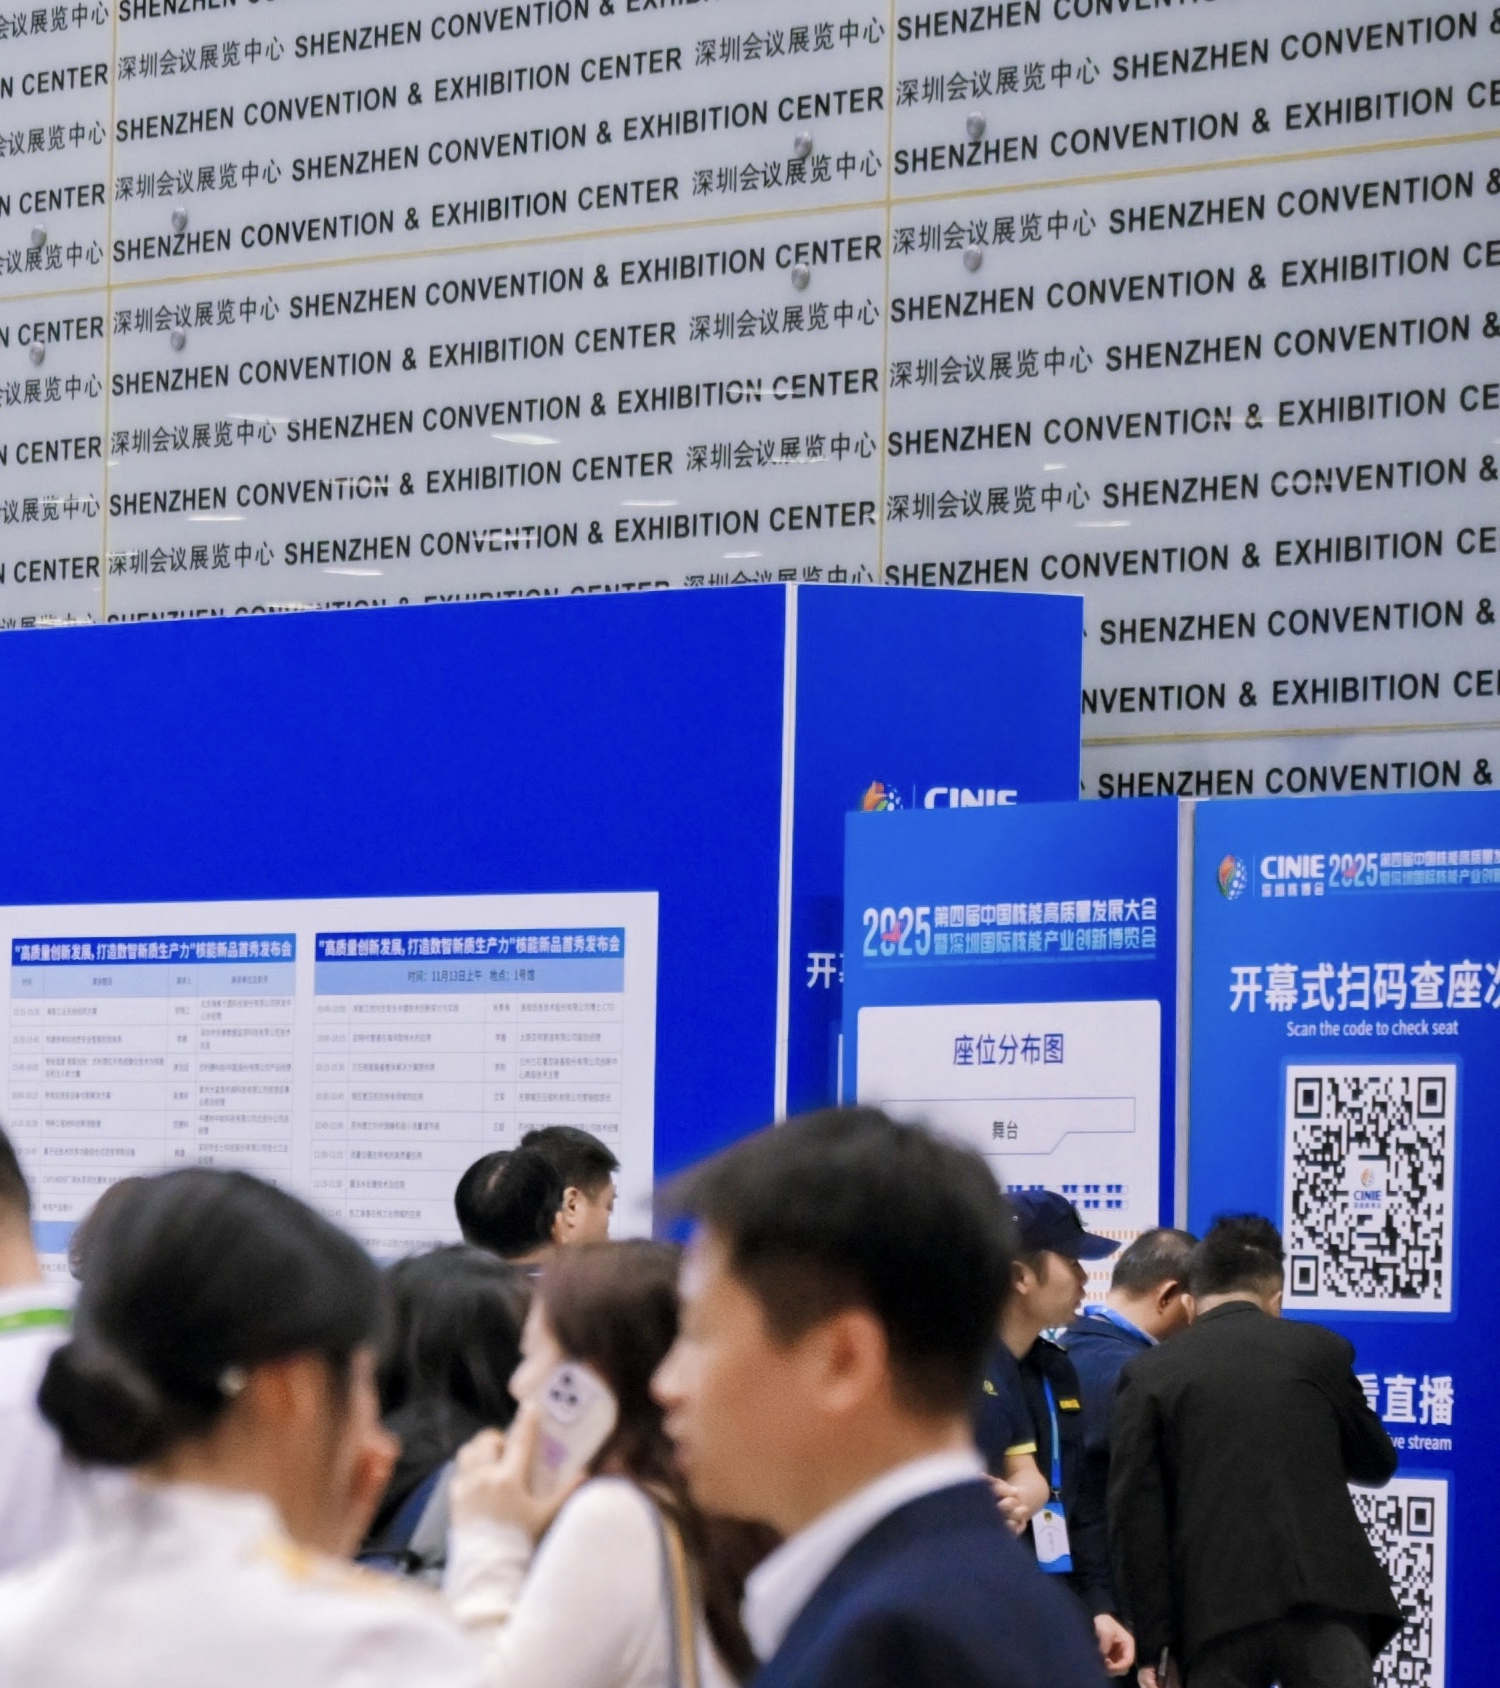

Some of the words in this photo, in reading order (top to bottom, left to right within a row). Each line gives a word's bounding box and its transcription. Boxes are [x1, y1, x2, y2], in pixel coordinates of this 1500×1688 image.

[895, 56, 1101, 107] 深圳会议展览中心
[1112, 37, 1269, 82] SHENZHEN
[1280, 10, 1478, 62] CONVENTION
[115, 105, 234, 143] SHENZHEN
[243, 85, 397, 127] CONVENTION
[407, 81, 423, 107] &
[434, 61, 570, 104] EXHIBITION
[580, 46, 682, 84] CENTER
[695, 16, 885, 67] 深圳会议展览中心
[890, 285, 1034, 324] SHENZHEN
[1046, 266, 1235, 309] CONVENTION
[1247, 263, 1267, 291] &
[1281, 244, 1450, 288] EXHIBITION
[1099, 611, 1256, 646] SHENZHEN
[1267, 599, 1464, 637] CONVENTION
[1475, 597, 1496, 626] &
[1260, 855, 1325, 880] CINIE
[1328, 853, 1379, 888] 2025
[934, 897, 1158, 929] 第四届中国核能高质量发展大会
[862, 906, 932, 958] 2025
[934, 926, 1157, 956] 暨深圳国际核能产业创新博览会
[1286, 1021, 1317, 1037] Scan
[1319, 1020, 1340, 1036] the
[1343, 1020, 1373, 1036] code
[1375, 1021, 1389, 1036] to
[1392, 1019, 1429, 1036] check
[1432, 1020, 1459, 1036] seat
[952, 1032, 1065, 1067] 座位分布图
[992, 1120, 1019, 1141] 舞台
[1387, 1434, 1405, 1450] ve
[1407, 1435, 1453, 1451] stream
